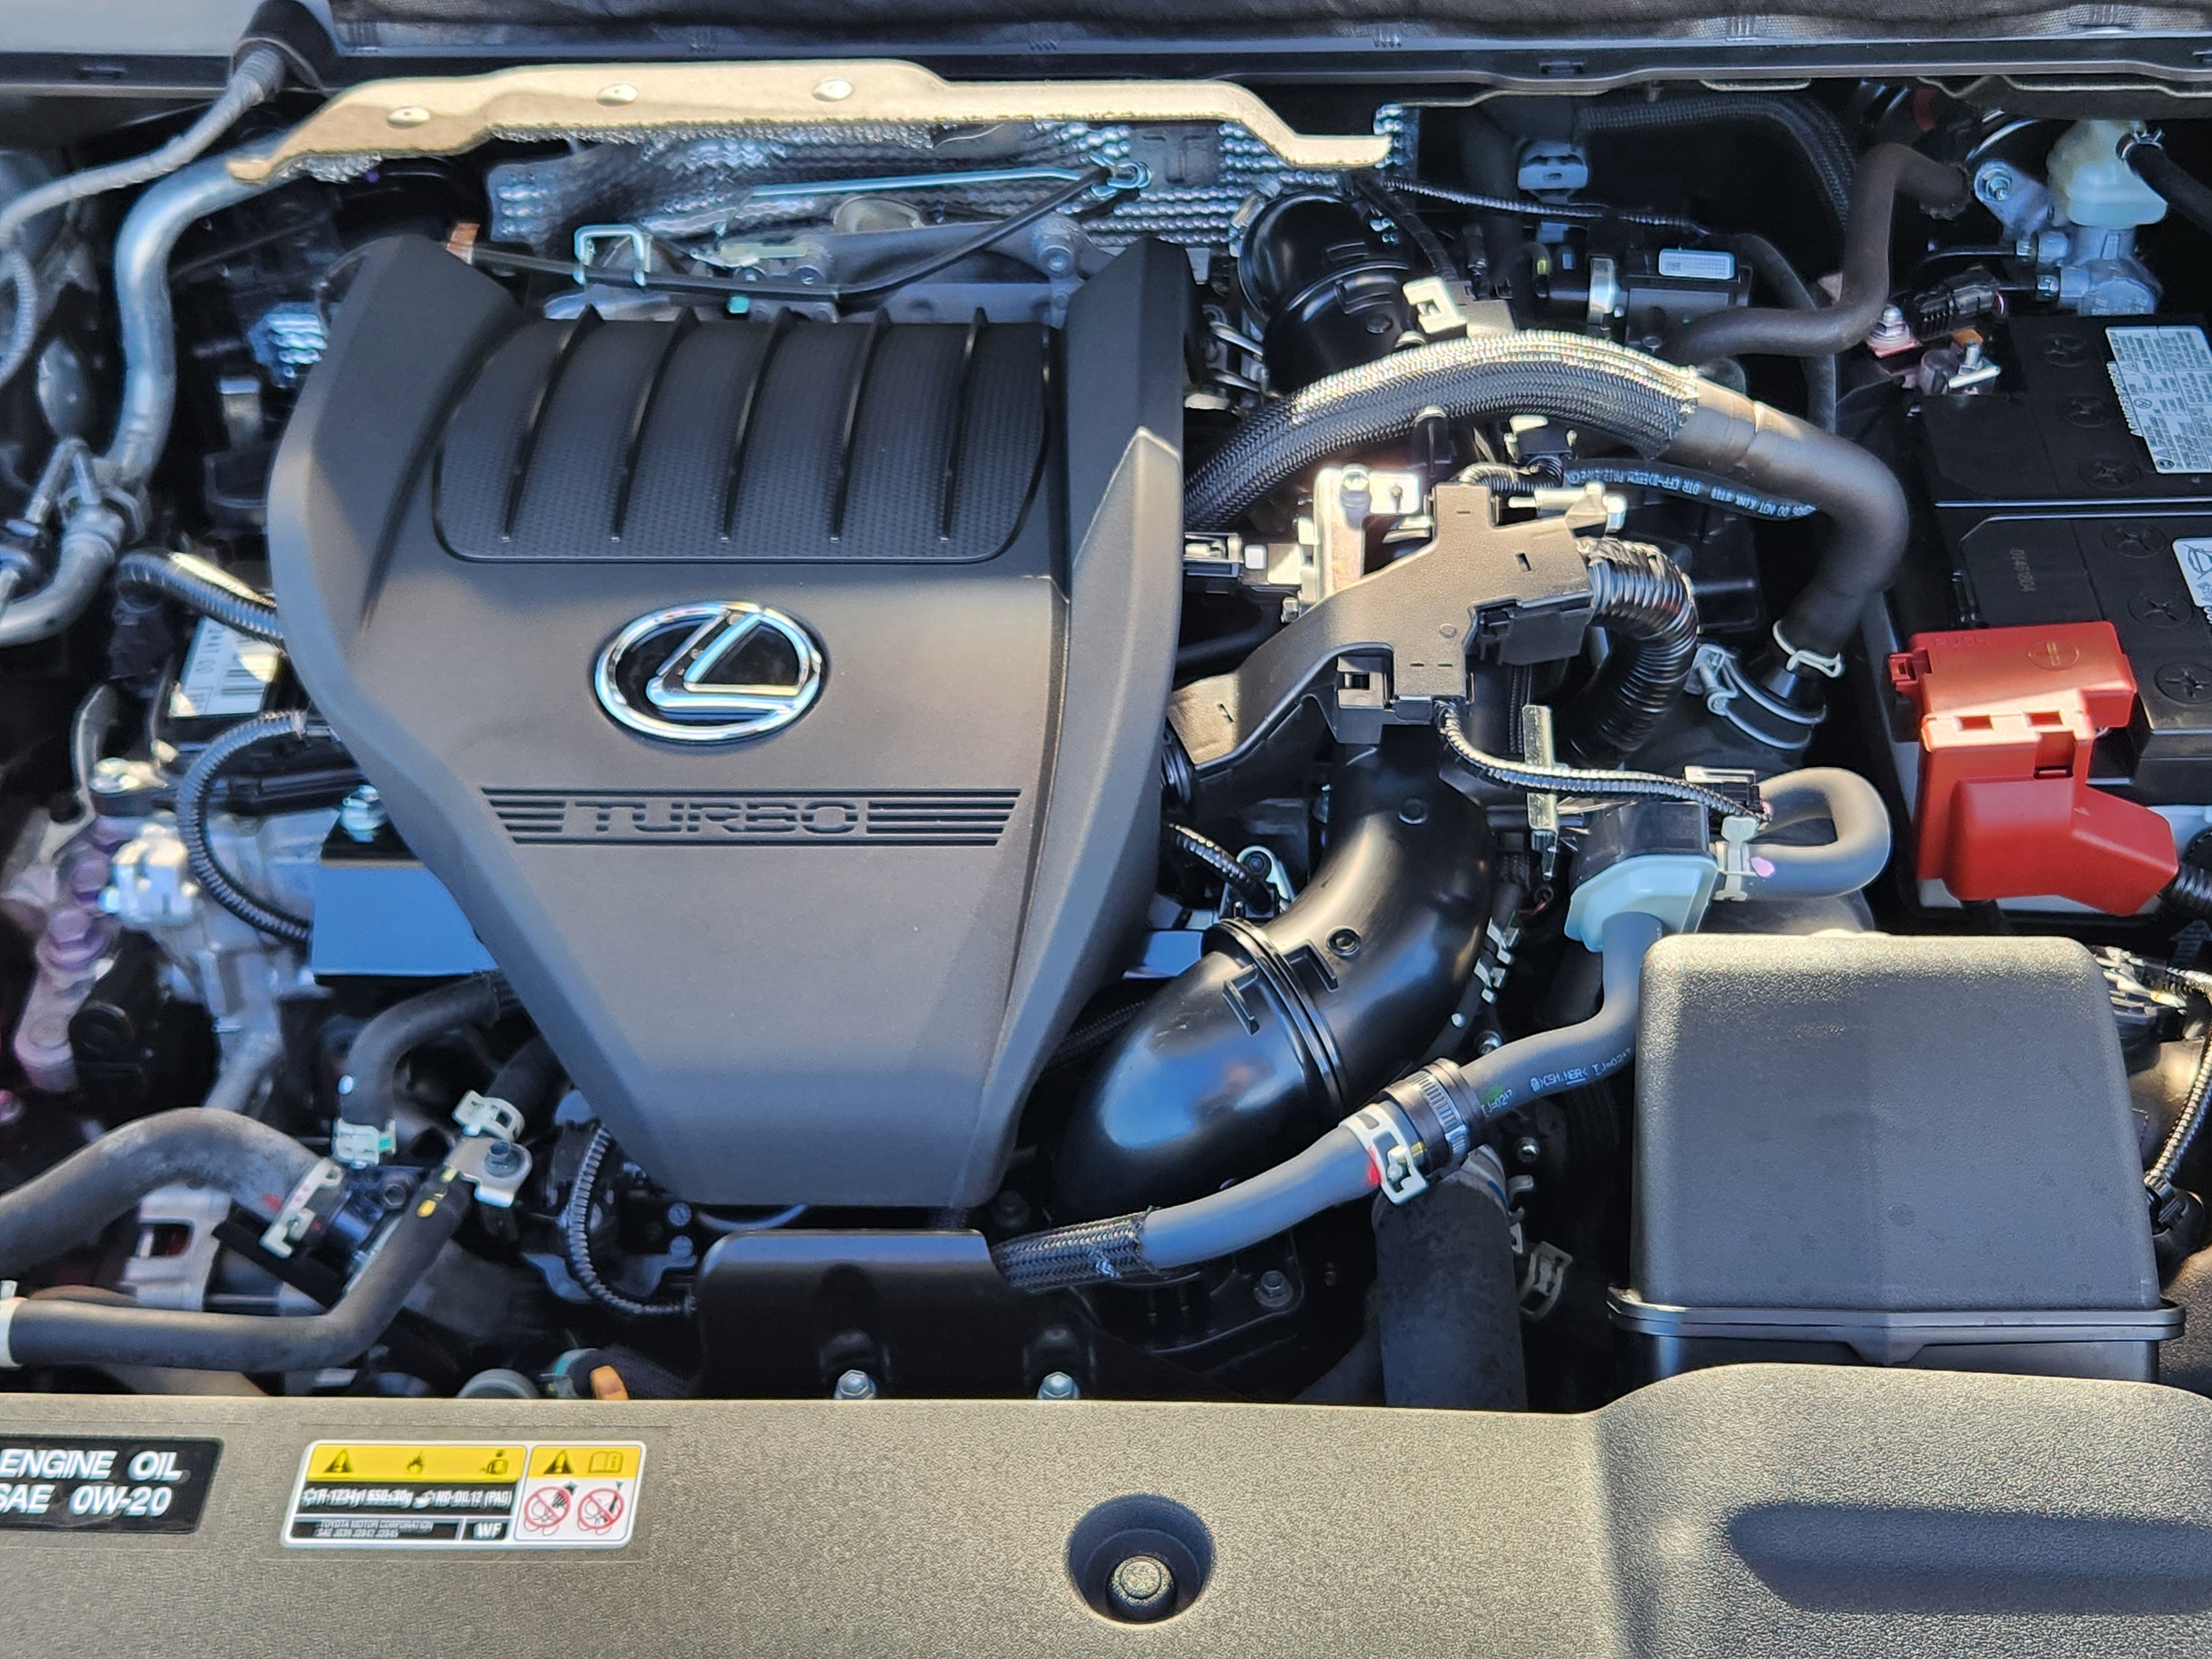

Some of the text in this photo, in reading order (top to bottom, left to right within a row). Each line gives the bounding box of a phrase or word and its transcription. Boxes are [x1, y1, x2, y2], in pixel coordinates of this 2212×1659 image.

[575, 800, 857, 833] TURBO
[0, 1448, 183, 1481] ENGINE OIL
[70, 1485, 173, 1517] 0W-20
[320, 1520, 434, 1530] TOYOTA MOTOR CORPORATION
[474, 1522, 502, 1538] WF
